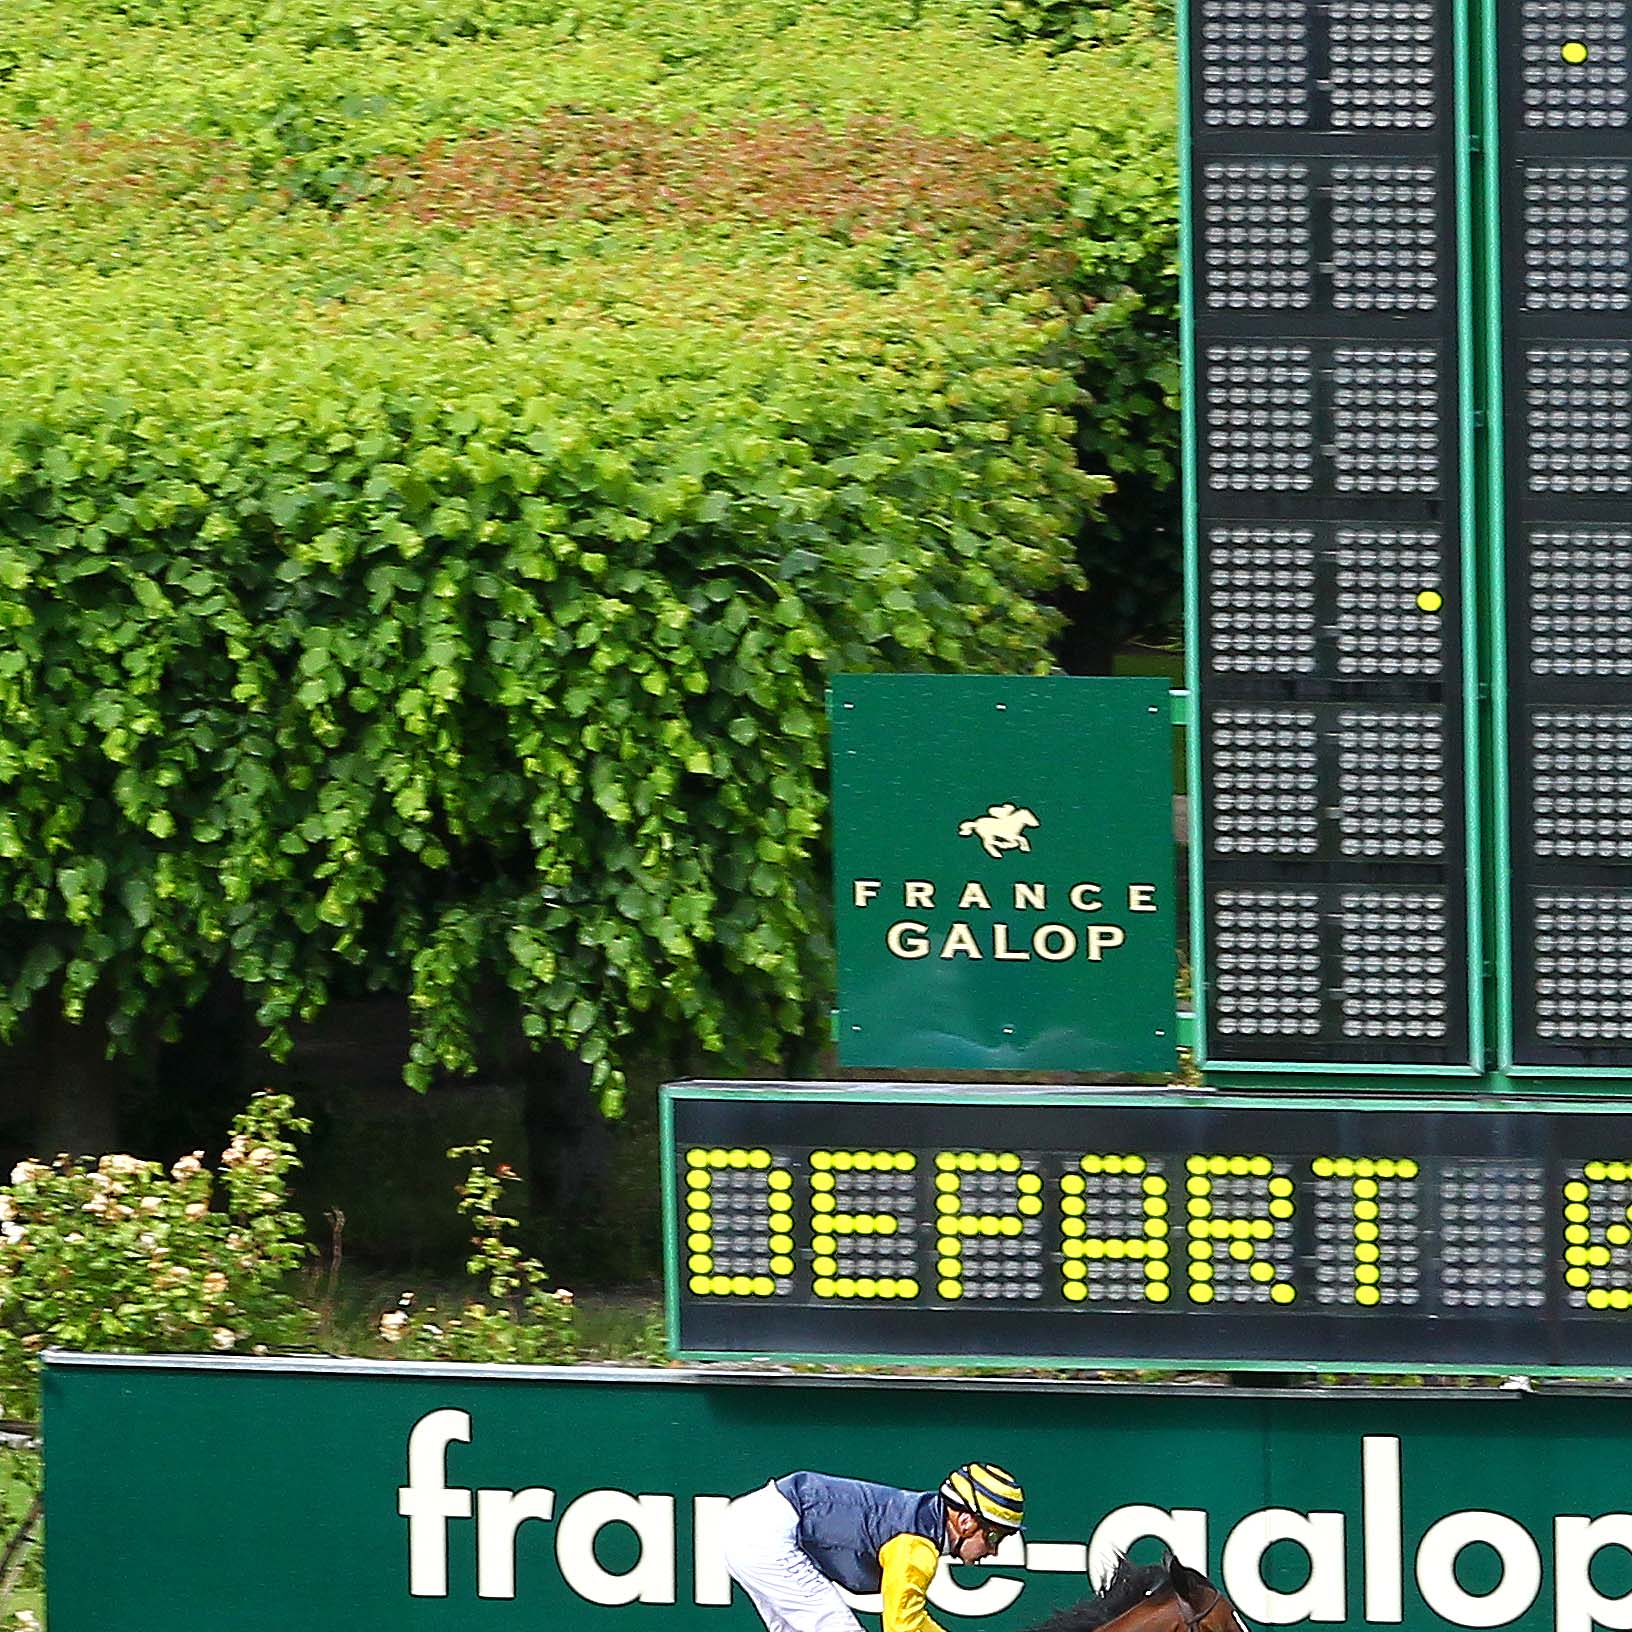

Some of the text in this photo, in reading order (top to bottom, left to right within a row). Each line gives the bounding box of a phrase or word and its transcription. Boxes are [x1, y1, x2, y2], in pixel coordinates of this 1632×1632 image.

[853, 880, 1158, 912] FRANCE
[886, 920, 1125, 961] GALOP
[686, 1147, 1420, 1305] DEPART
